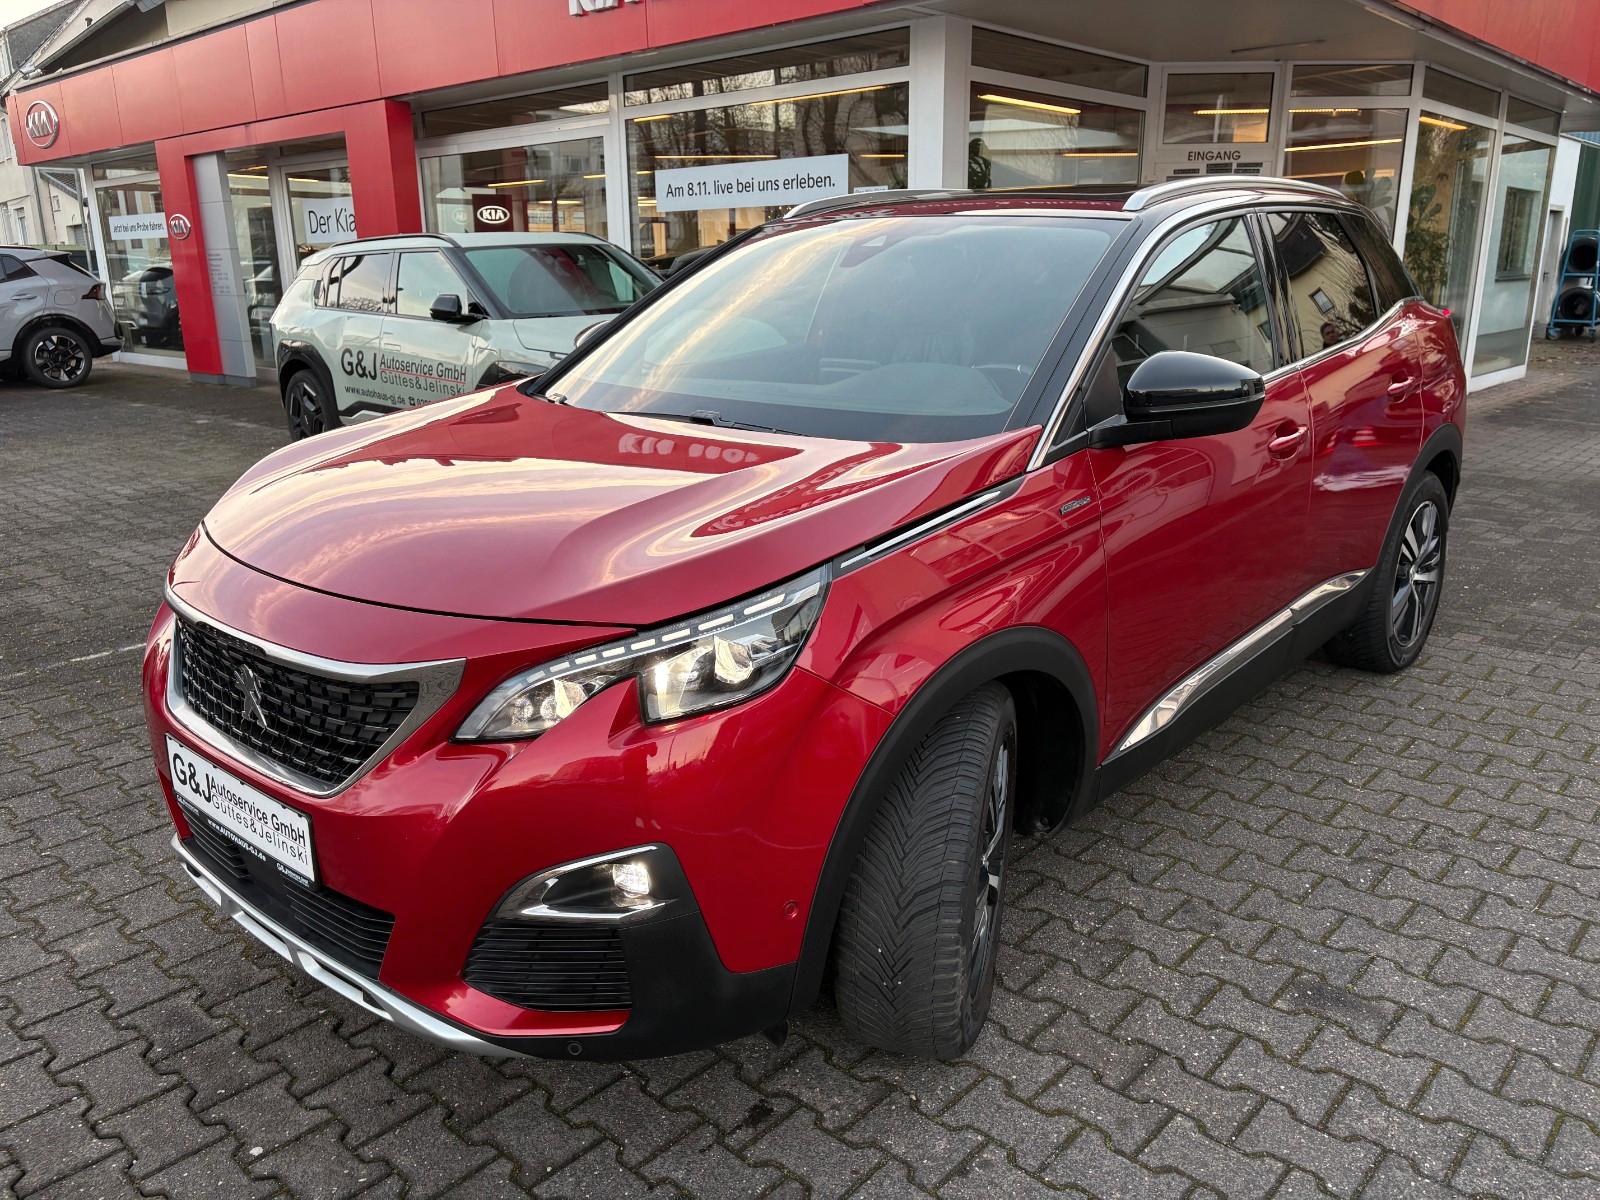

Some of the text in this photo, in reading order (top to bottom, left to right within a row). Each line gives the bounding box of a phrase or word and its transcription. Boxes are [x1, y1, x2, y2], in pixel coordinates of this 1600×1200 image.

[1187, 150, 1241, 161] EINGANG
[666, 173, 836, 198] Am 8.11. live bei uns erleben.
[308, 207, 356, 234] Der Kia
[482, 209, 505, 220] KIA
[341, 348, 377, 381] G&J
[379, 354, 467, 382] Autoservice GmbH
[172, 752, 211, 803] G&J
[210, 775, 268, 825] Autoservice
[271, 813, 306, 848] GmbH
